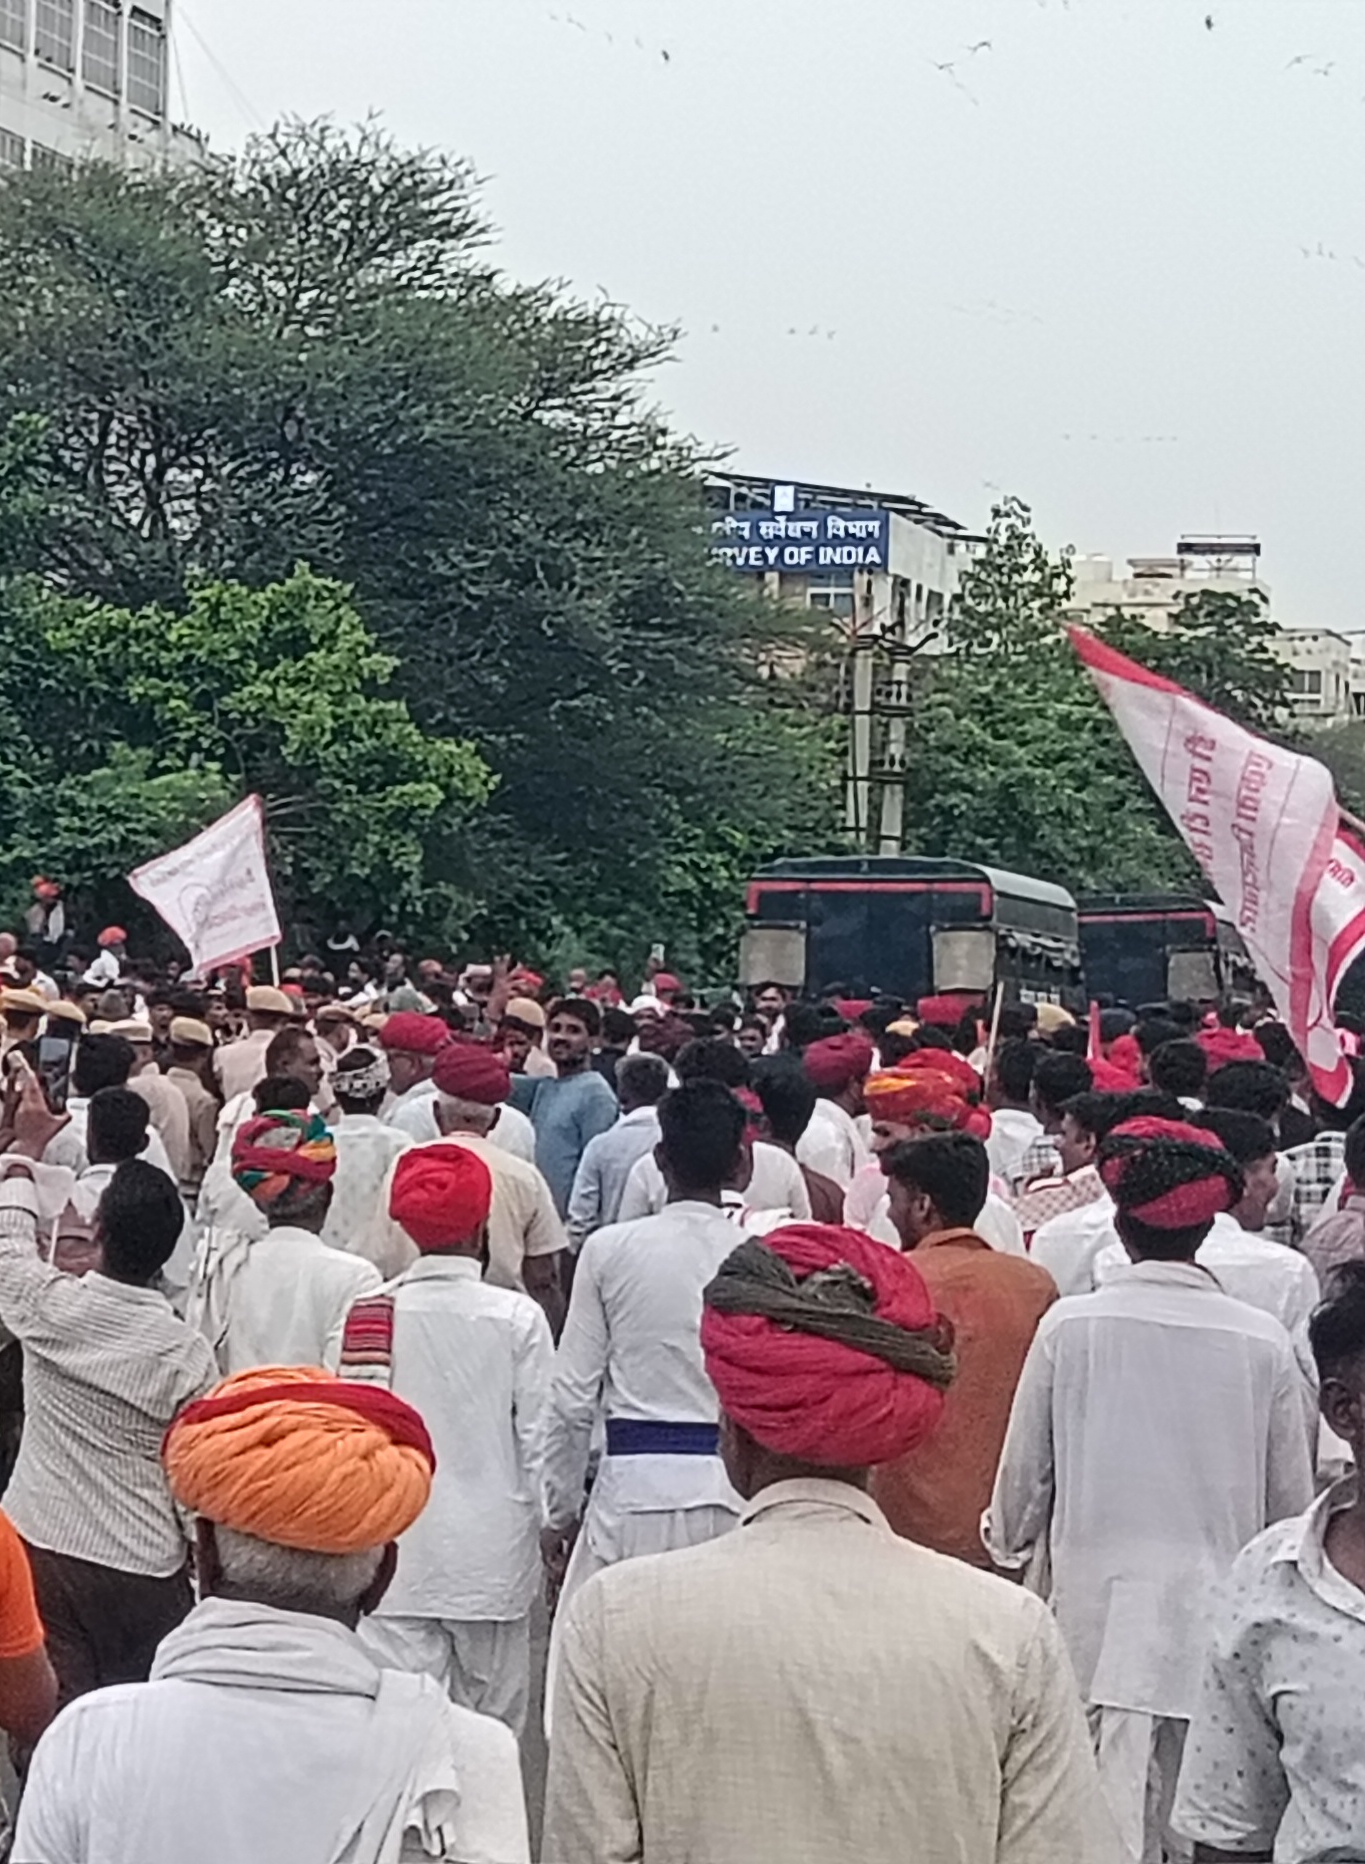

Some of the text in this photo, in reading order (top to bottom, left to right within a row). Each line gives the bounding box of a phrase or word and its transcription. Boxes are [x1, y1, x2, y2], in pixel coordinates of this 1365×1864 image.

[826, 514, 881, 540] विभाग
[707, 546, 882, 567] RVEY OF INDIA
